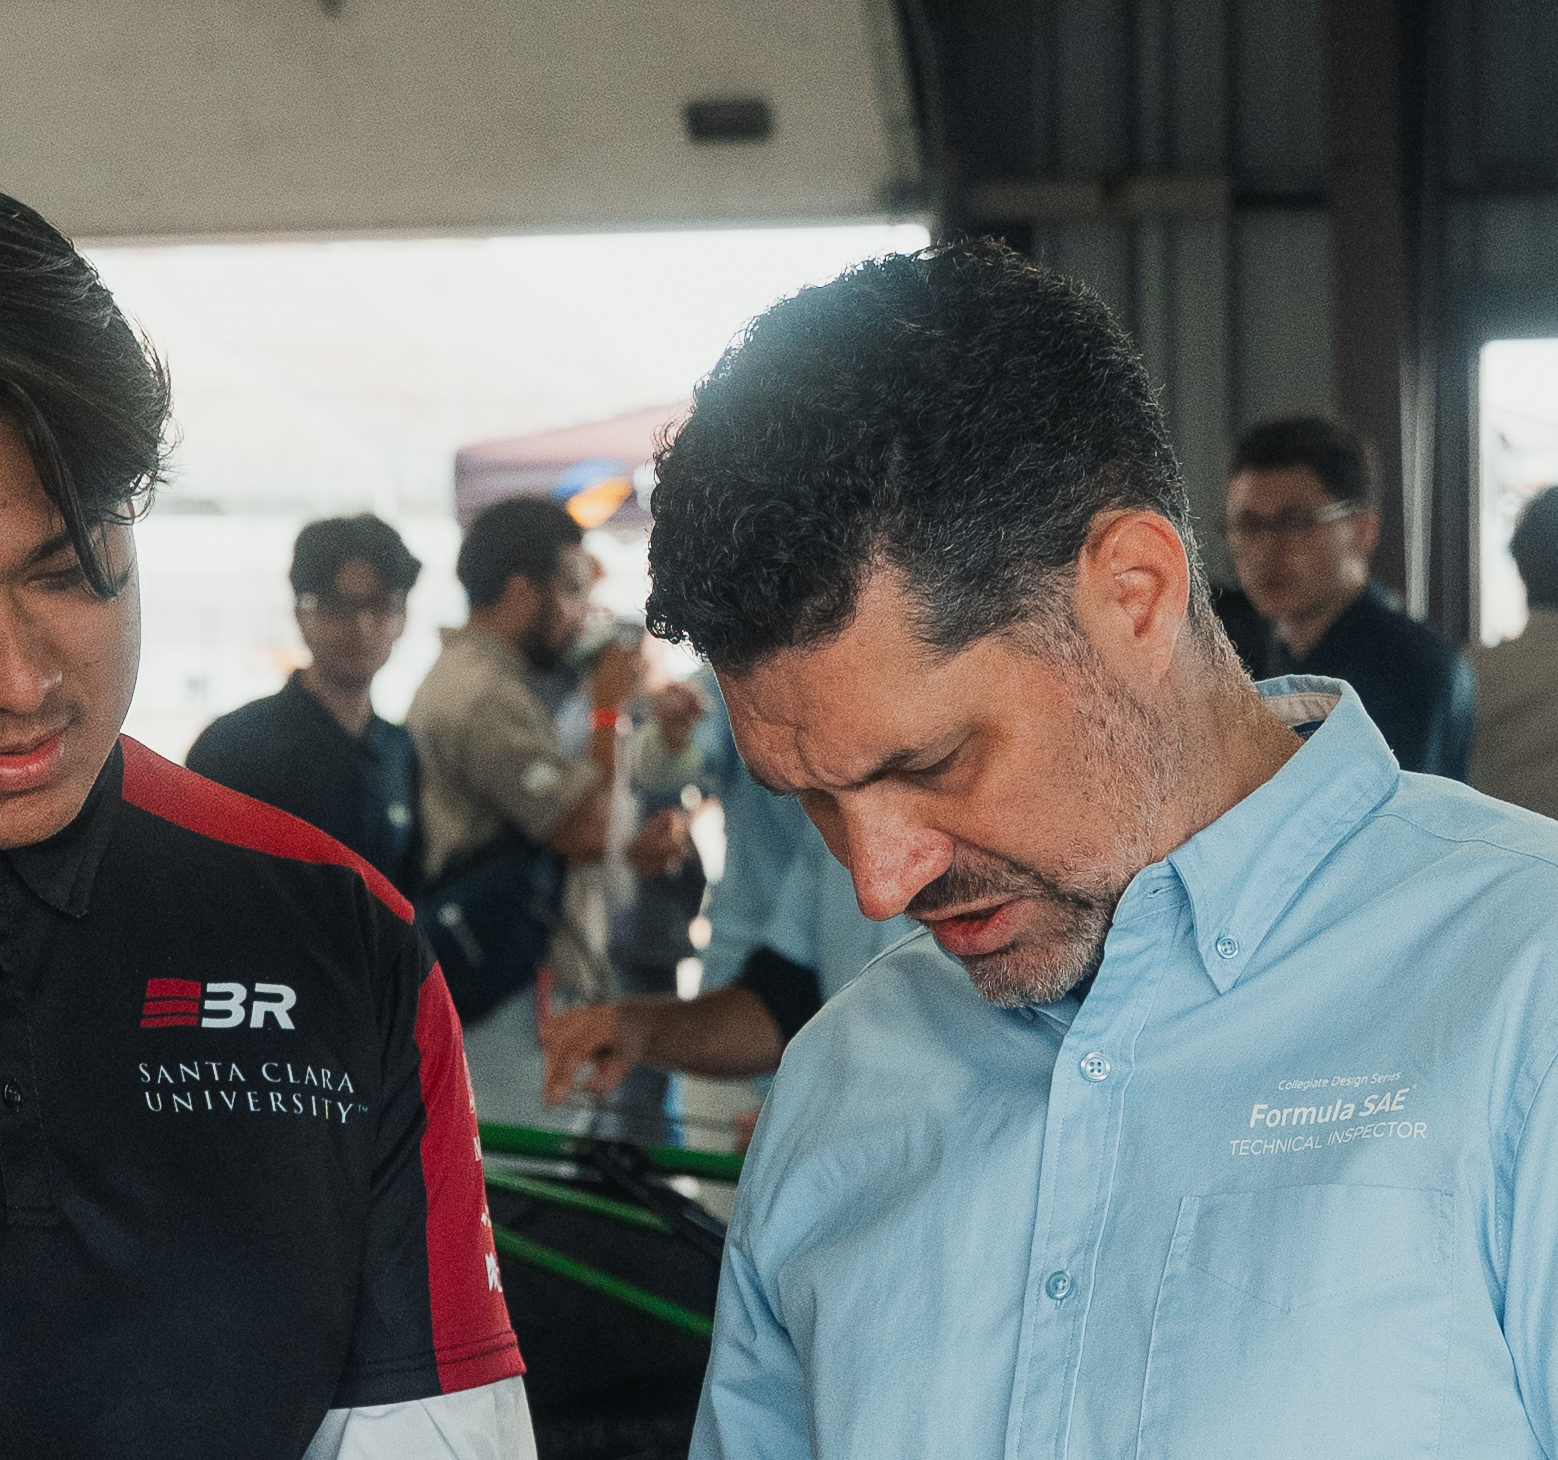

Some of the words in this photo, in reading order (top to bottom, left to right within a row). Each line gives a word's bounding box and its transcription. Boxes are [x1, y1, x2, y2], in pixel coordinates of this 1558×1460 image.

[138, 1060, 246, 1084] SANTA
[261, 1061, 355, 1094] CLARA
[1277, 1077, 1330, 1091] Collegiate
[1330, 1075, 1369, 1088] Design
[1370, 1071, 1402, 1085] Series
[1249, 1098, 1356, 1129] Formula
[1229, 1134, 1324, 1157] TECHNICAL
[1326, 1120, 1428, 1147] INSPECTOR
